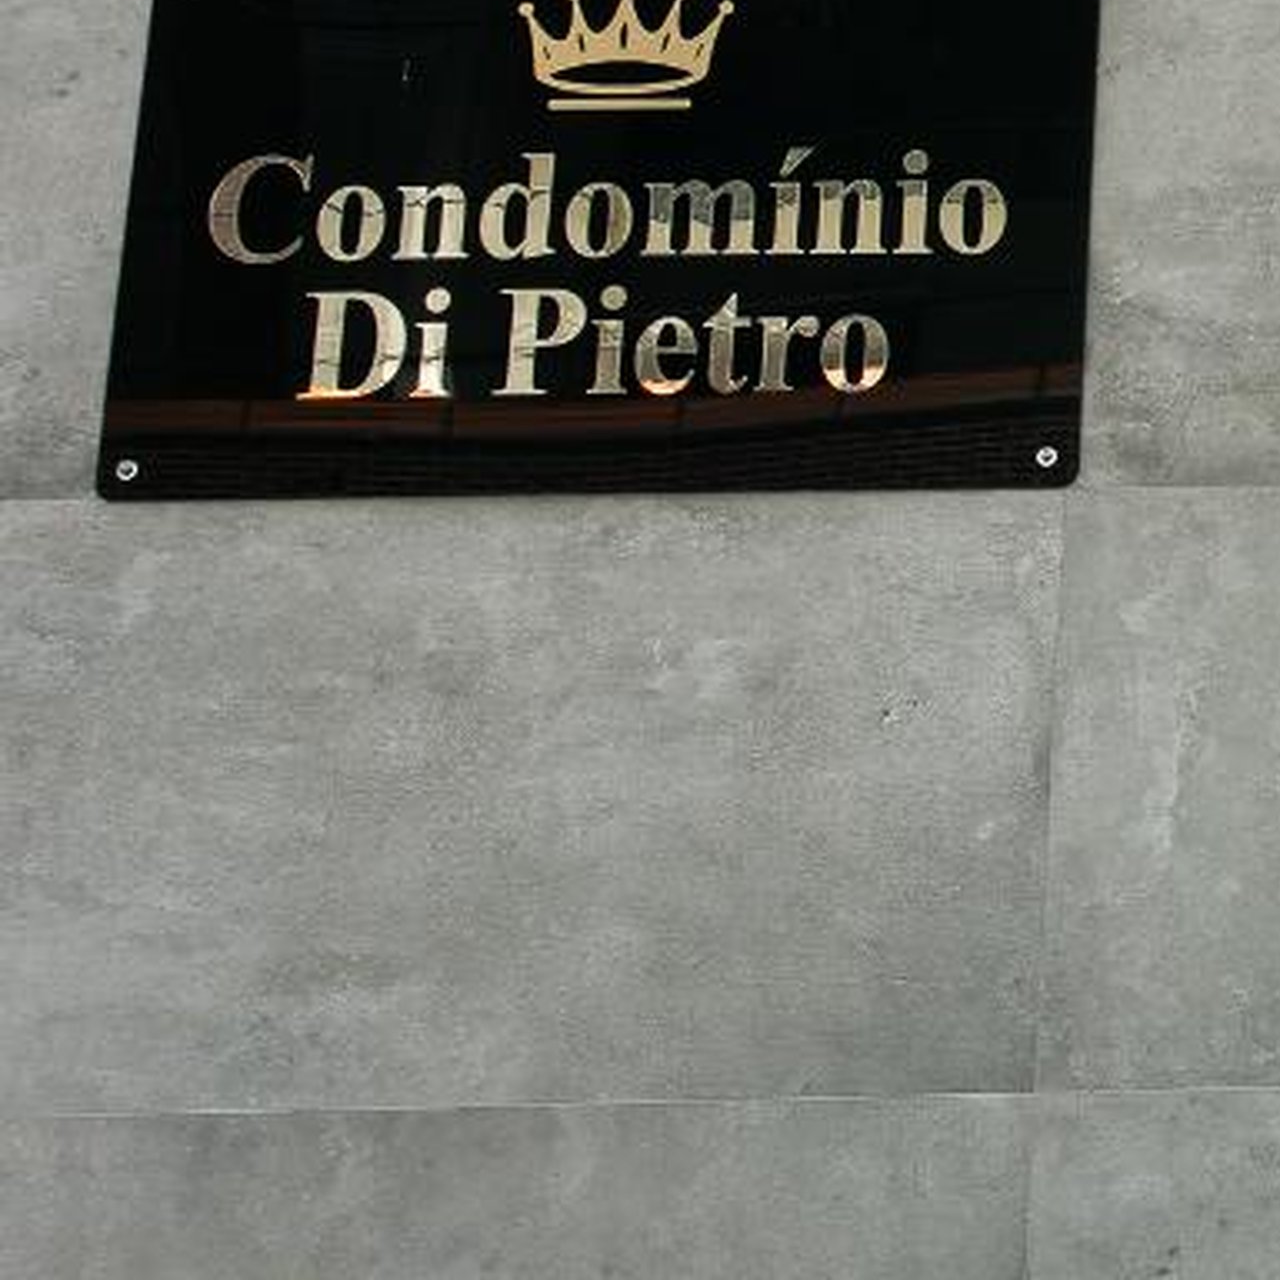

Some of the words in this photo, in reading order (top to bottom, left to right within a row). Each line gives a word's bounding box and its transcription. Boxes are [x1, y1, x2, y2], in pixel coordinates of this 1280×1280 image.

[207, 147, 1007, 265] Condomínio
[296, 285, 453, 400] Di
[491, 284, 890, 397] Pietro
